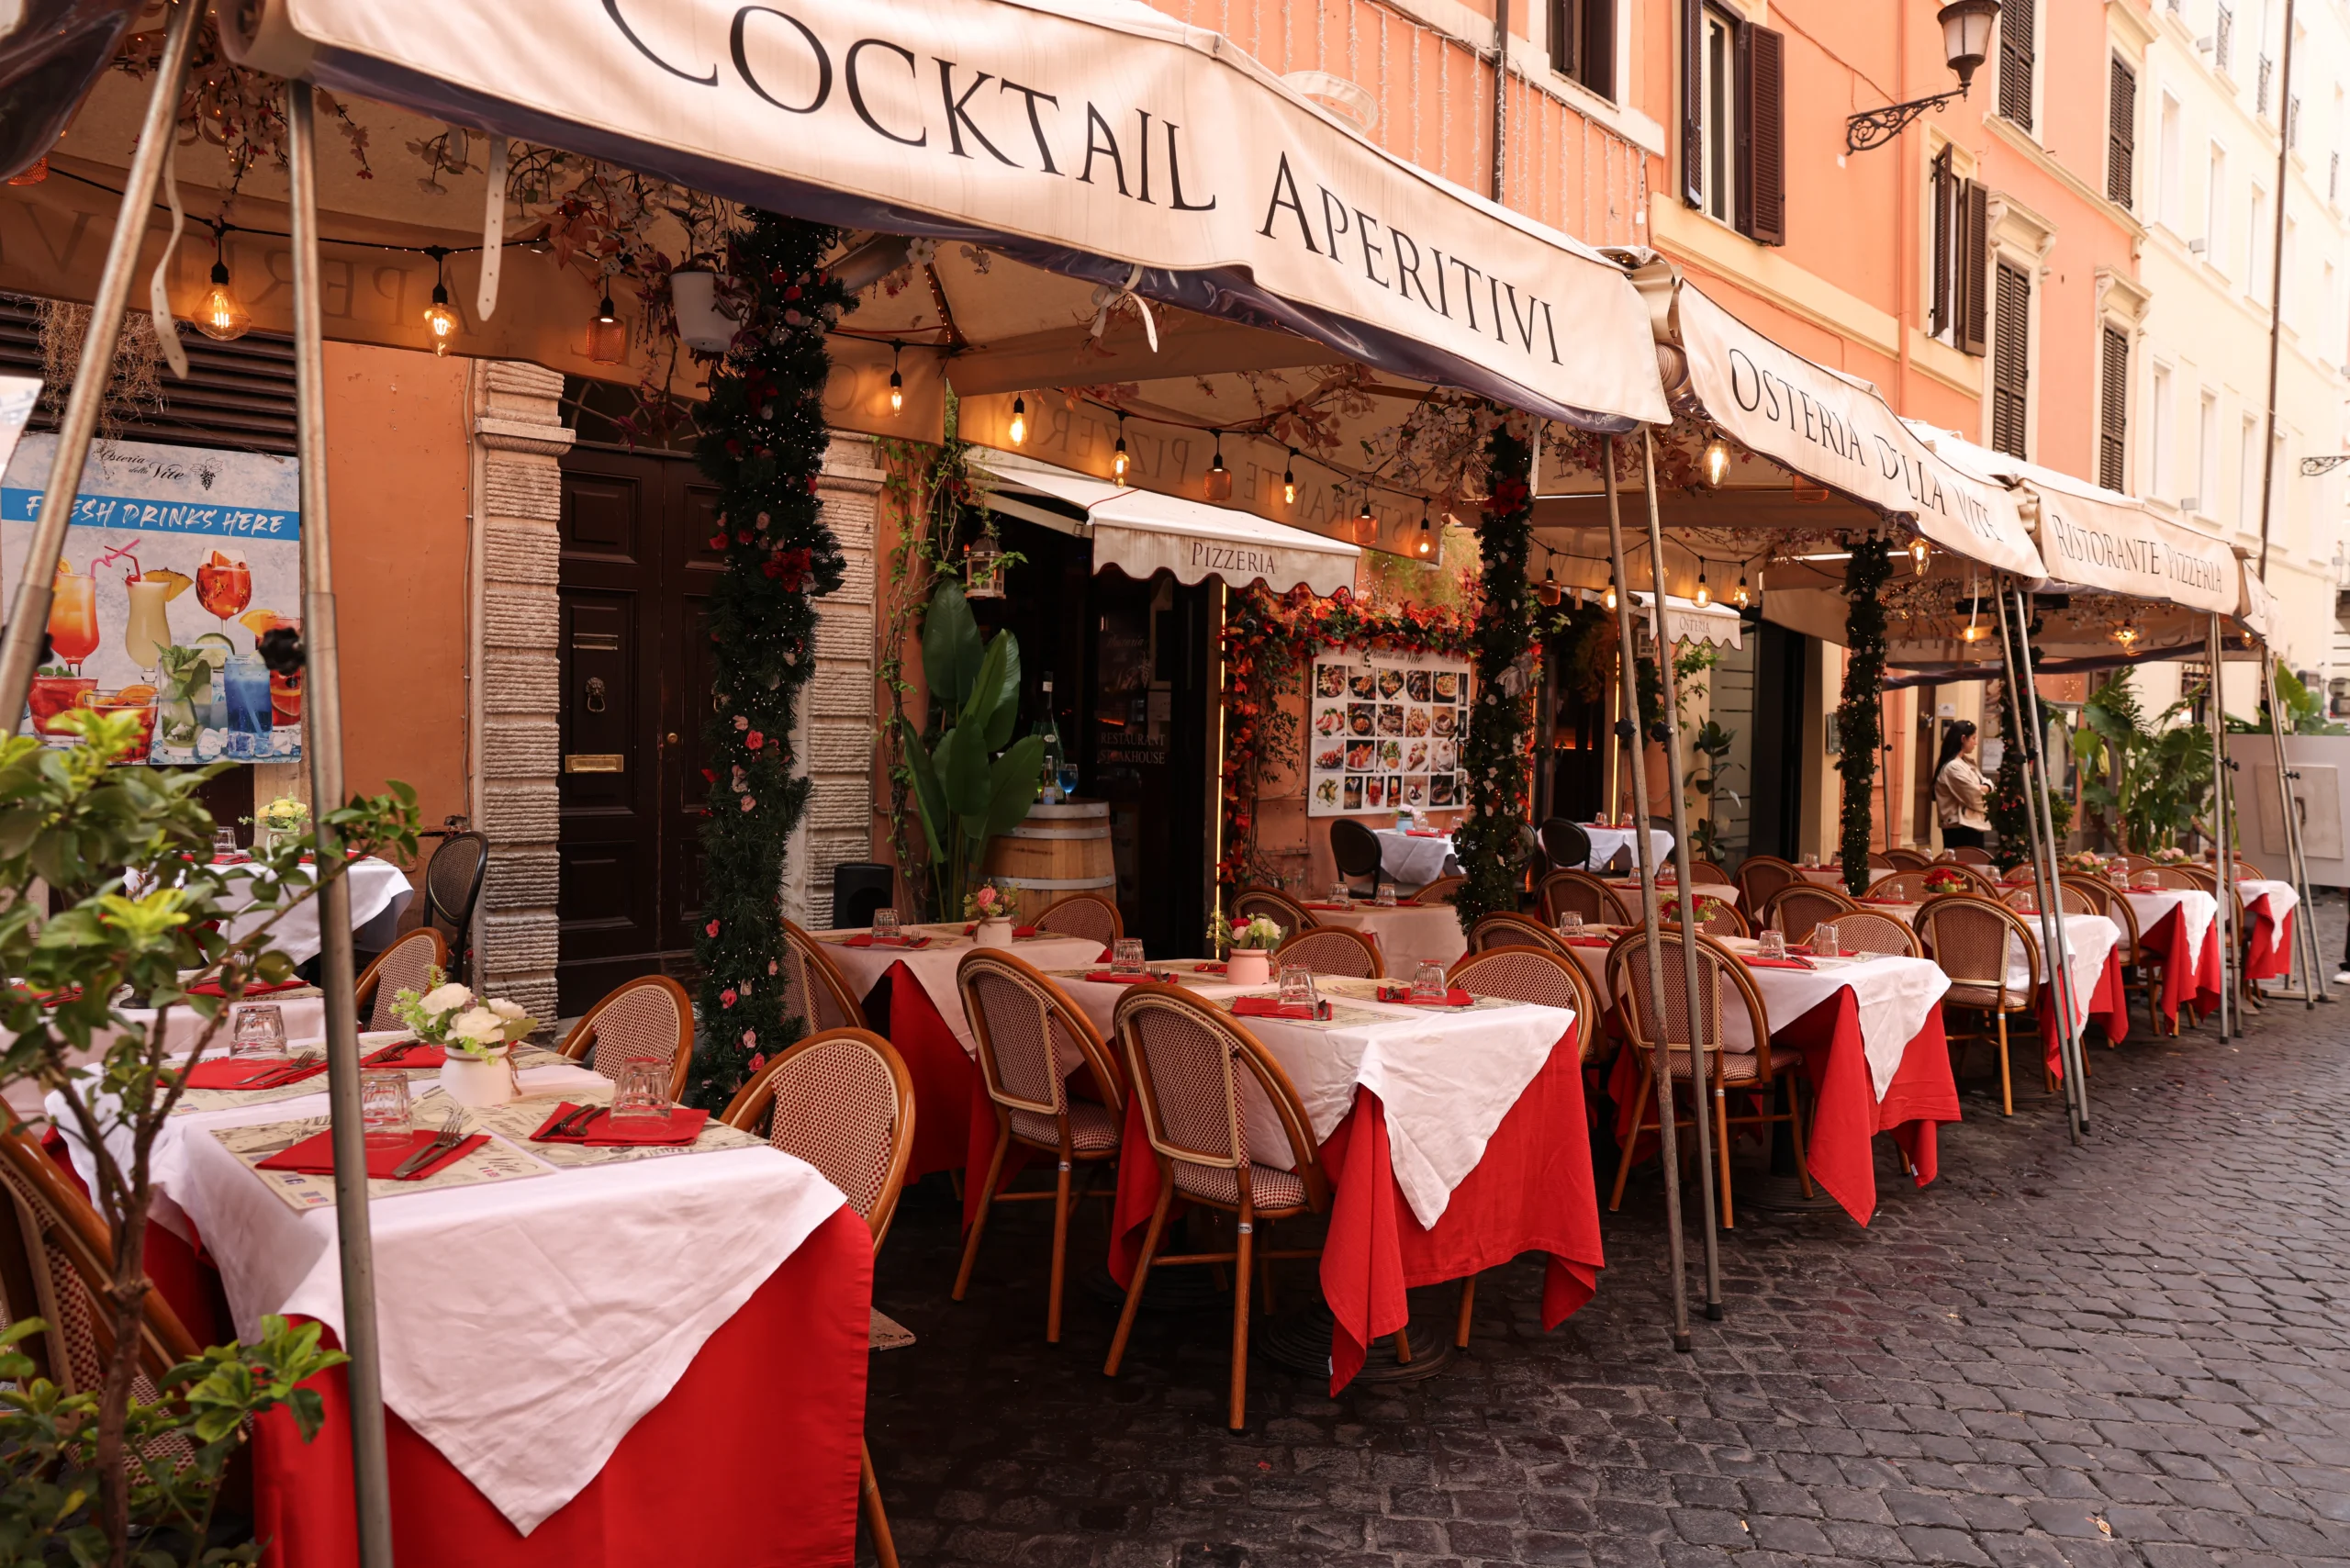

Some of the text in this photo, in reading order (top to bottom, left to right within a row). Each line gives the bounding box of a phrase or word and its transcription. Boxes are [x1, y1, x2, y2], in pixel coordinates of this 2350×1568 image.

[1255, 150, 1564, 366] APERITIVI
[1729, 348, 1867, 466] OSTERIA
[1873, 433, 1948, 517] DLLA
[100, 448, 146, 465] Osteria
[128, 461, 185, 481] della Vite
[26, 495, 285, 536] FESH DRINKS HERE
[1191, 542, 1276, 575] PIZZERIA
[2052, 514, 2222, 594] RISTORANTE PIZZERIA
[1679, 616, 1711, 633] OSTERIA
[1101, 732, 1166, 746] RESTAURANT
